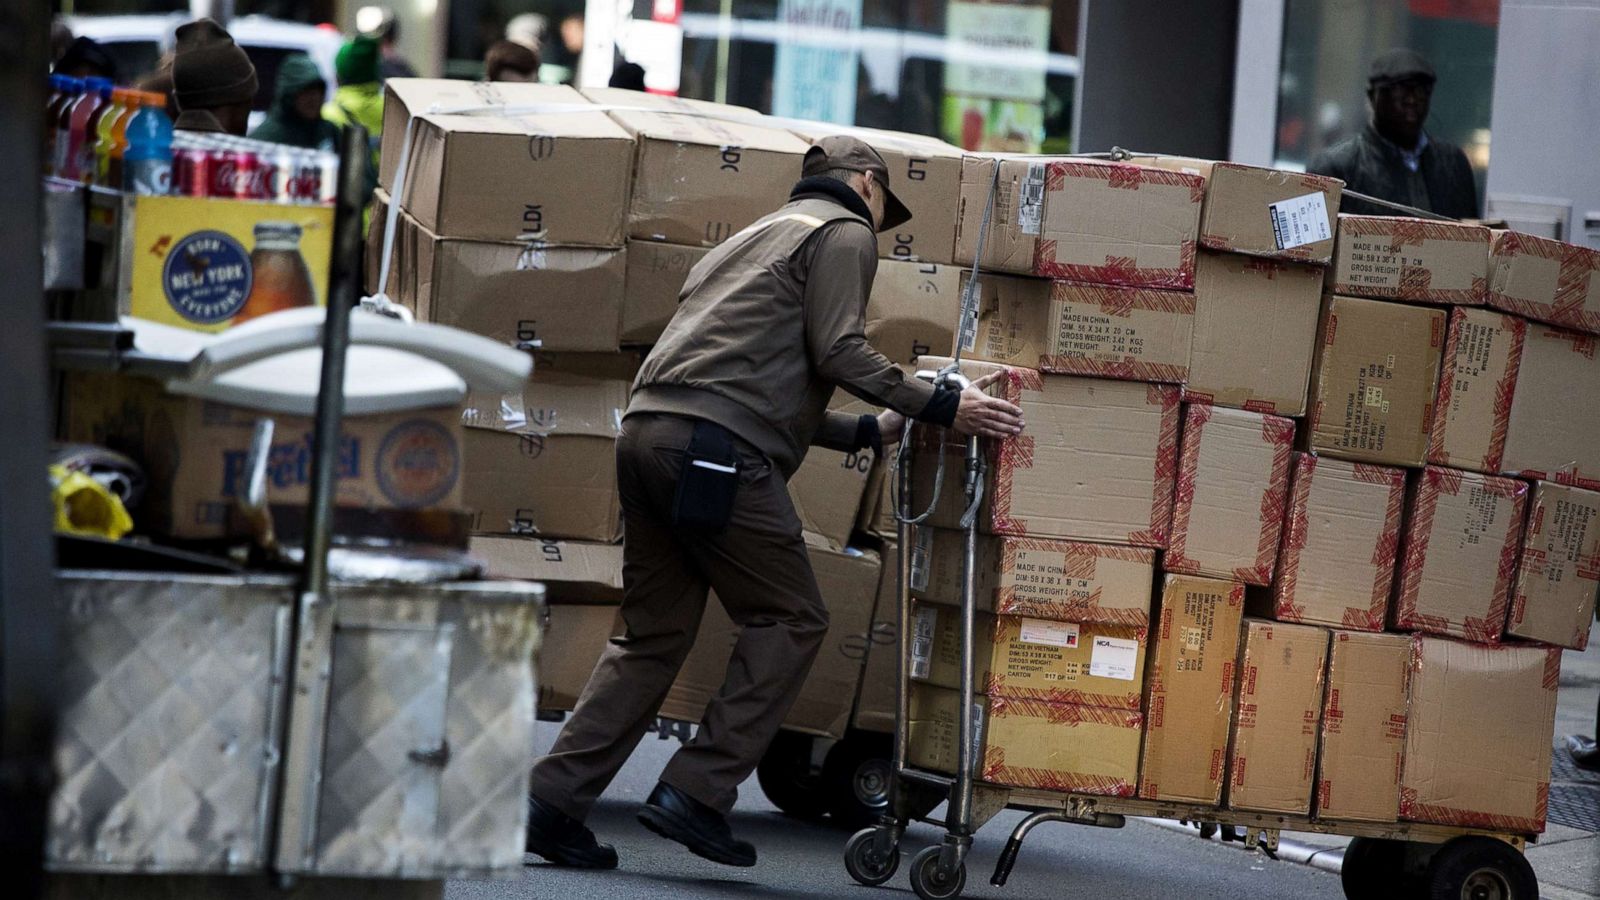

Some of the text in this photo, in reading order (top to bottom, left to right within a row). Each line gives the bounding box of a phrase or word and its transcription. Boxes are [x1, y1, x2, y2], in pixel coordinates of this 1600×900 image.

[1353, 243, 1371, 251] MADE
[1383, 245, 1402, 254] CHINA
[1351, 264, 1372, 272] GROSS
[207, 264, 244, 285] YORK
[1061, 332, 1083, 340] GROSS
[1471, 324, 1479, 342] GROSS
[1129, 346, 1143, 354] KGS
[1481, 349, 1490, 371] VIETNAM
[1360, 368, 1366, 377] CM
[1386, 371, 1392, 379] OF
[1186, 391, 1213, 400] CAUTION
[1358, 391, 1364, 401] CM
[1343, 429, 1351, 447] MADE
[1347, 393, 1355, 420] VIETNAM
[1355, 415, 1361, 426] CM
[1360, 427, 1368, 448] GROSS
[1568, 503, 1576, 525] GROSS
[1548, 500, 1563, 551] CARTON OF
[1568, 552, 1574, 560] CM
[1017, 563, 1035, 571] MADE
[1047, 566, 1067, 575] CHINA
[1015, 584, 1036, 592] GROSS
[1162, 609, 1172, 639] CAUTION
[1009, 657, 1029, 665] GROSS
[1248, 666, 1257, 694] CAUTION
[1155, 697, 1164, 727] CAUTION
